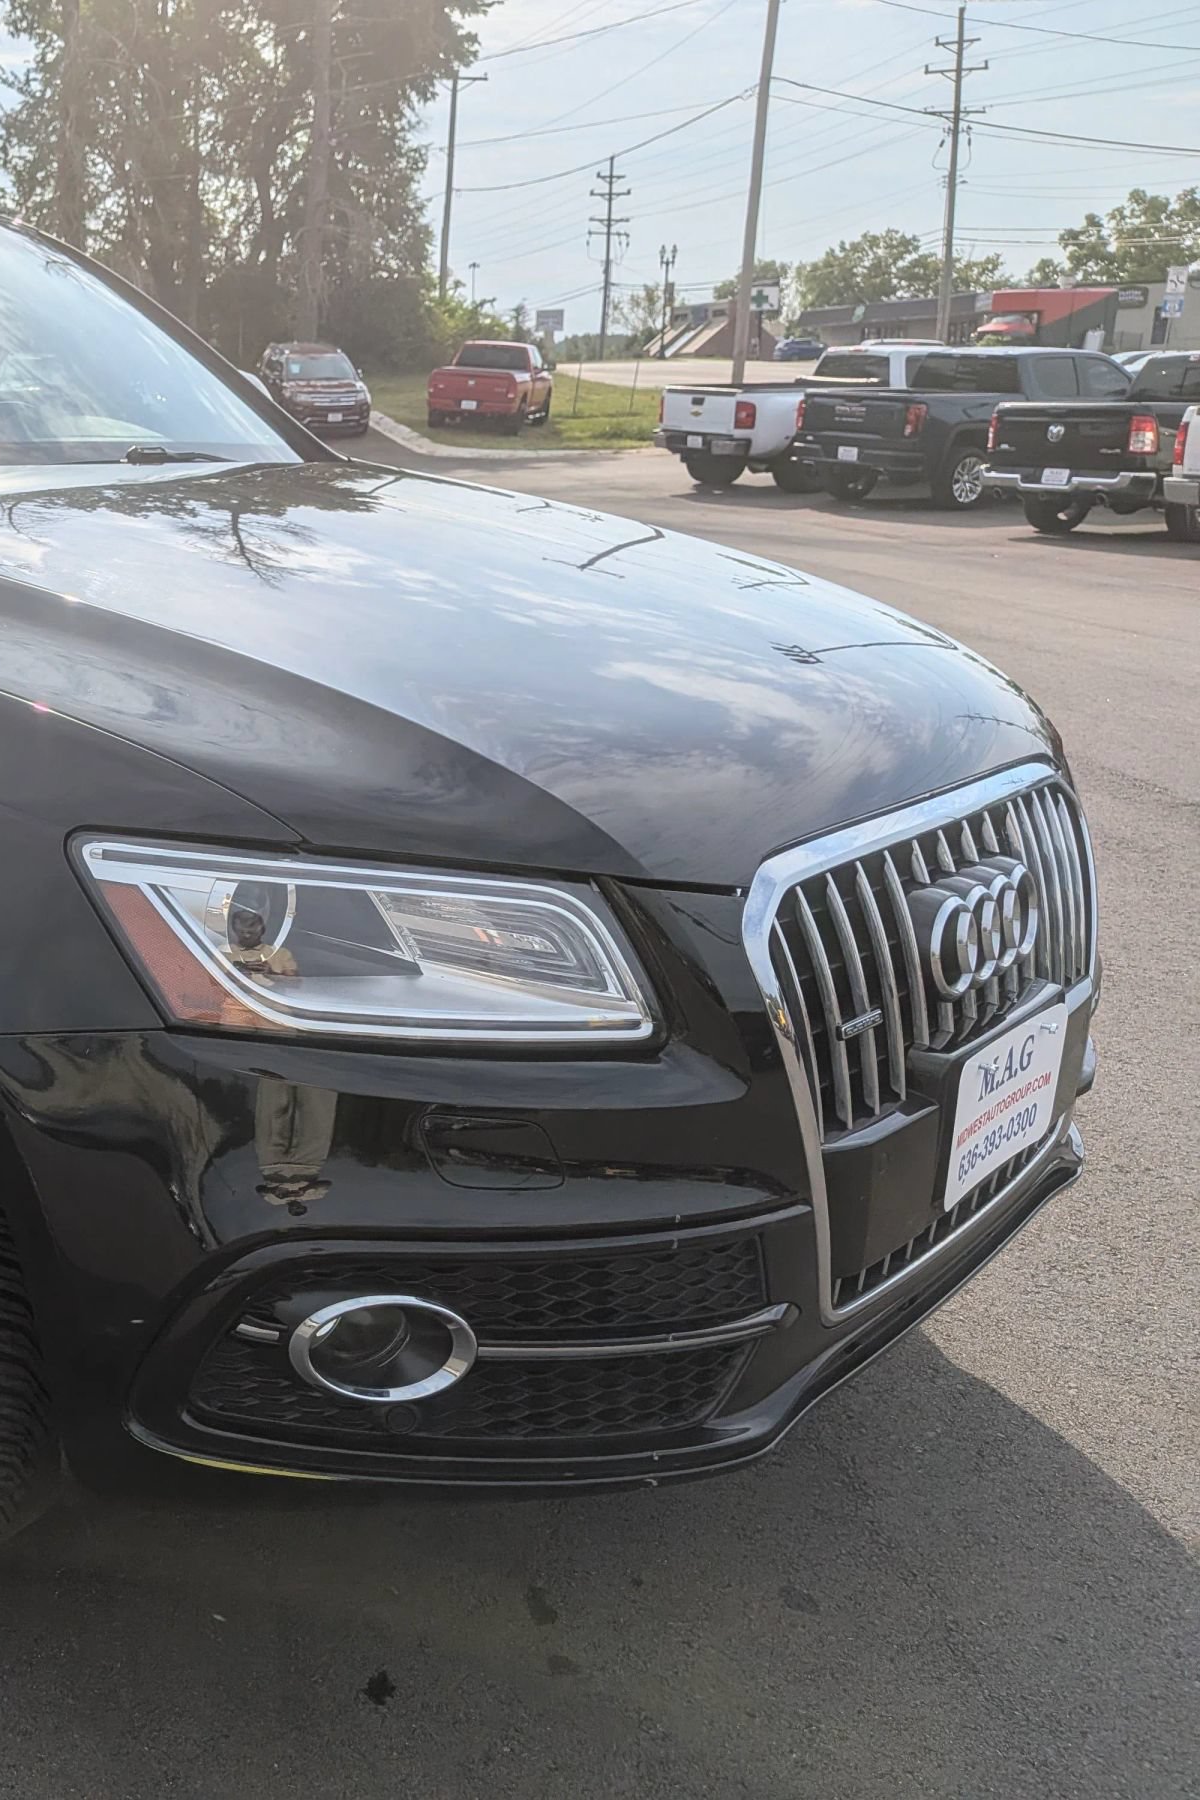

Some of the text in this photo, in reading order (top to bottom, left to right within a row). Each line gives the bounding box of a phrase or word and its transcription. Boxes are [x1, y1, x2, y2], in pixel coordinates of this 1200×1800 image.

[977, 1034, 1036, 1102] M.A.G
[955, 1071, 1052, 1150] MIDWESTAUTOGROUP.COM
[958, 1102, 1038, 1182] 636-393-0300
